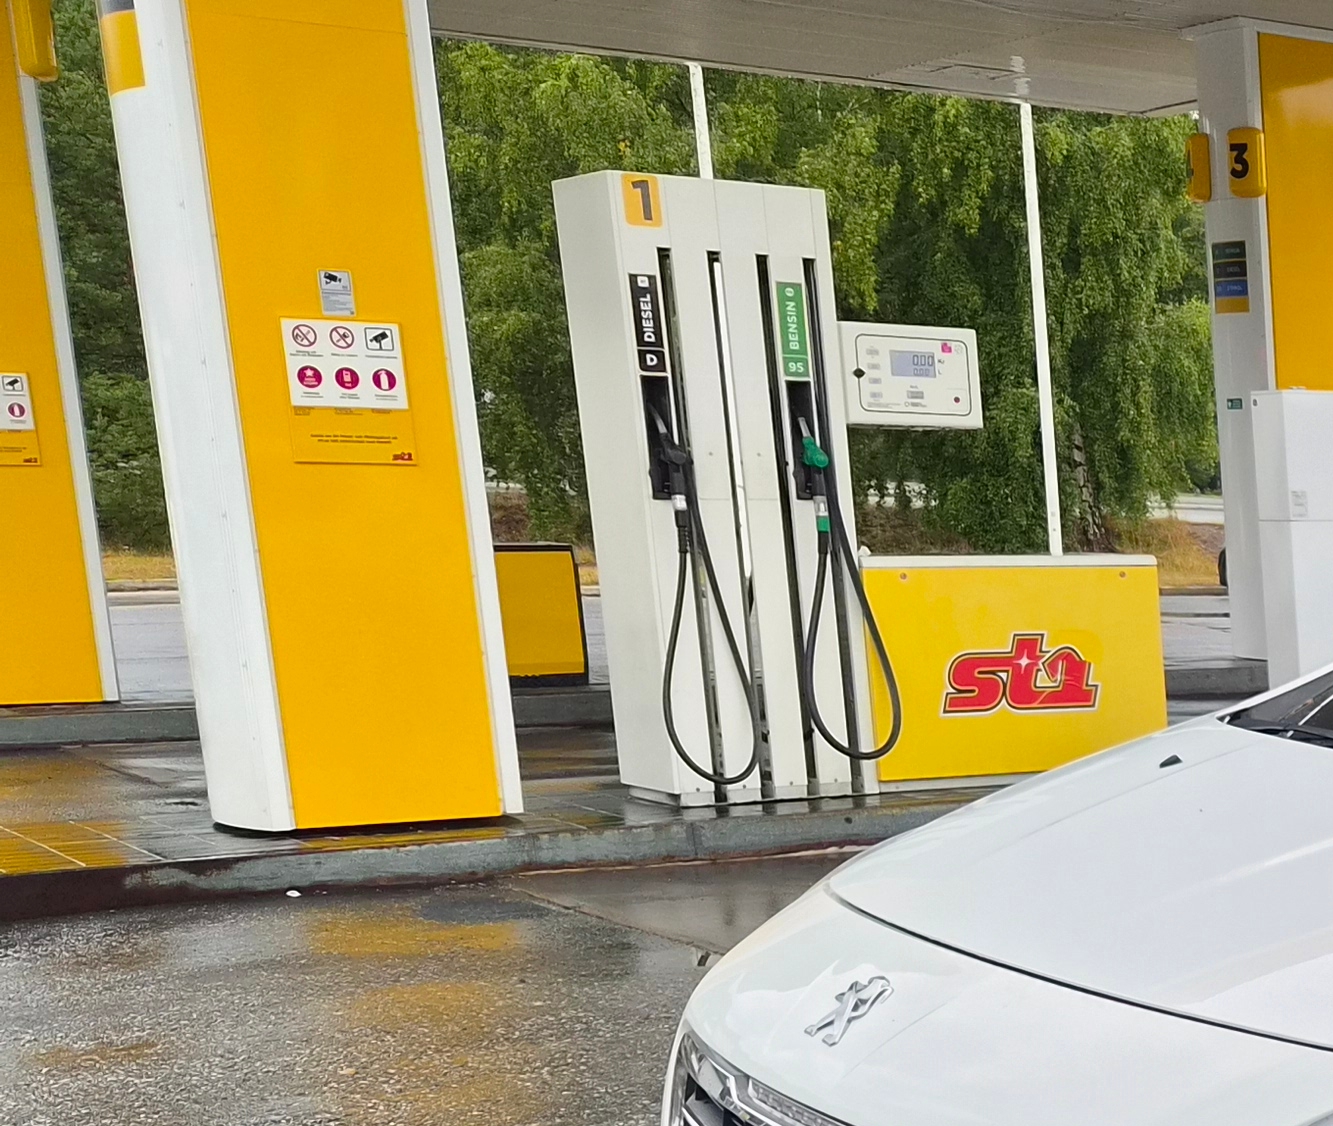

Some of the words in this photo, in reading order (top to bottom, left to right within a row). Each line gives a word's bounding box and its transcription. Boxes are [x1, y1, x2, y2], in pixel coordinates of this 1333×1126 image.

[1228, 142, 1250, 179] 3
[630, 179, 654, 221] 1
[638, 293, 656, 343] DIESEL
[785, 301, 800, 350] BENSIN
[646, 354, 658, 366] D
[788, 362, 804, 373] 95
[942, 632, 1099, 714] st1
